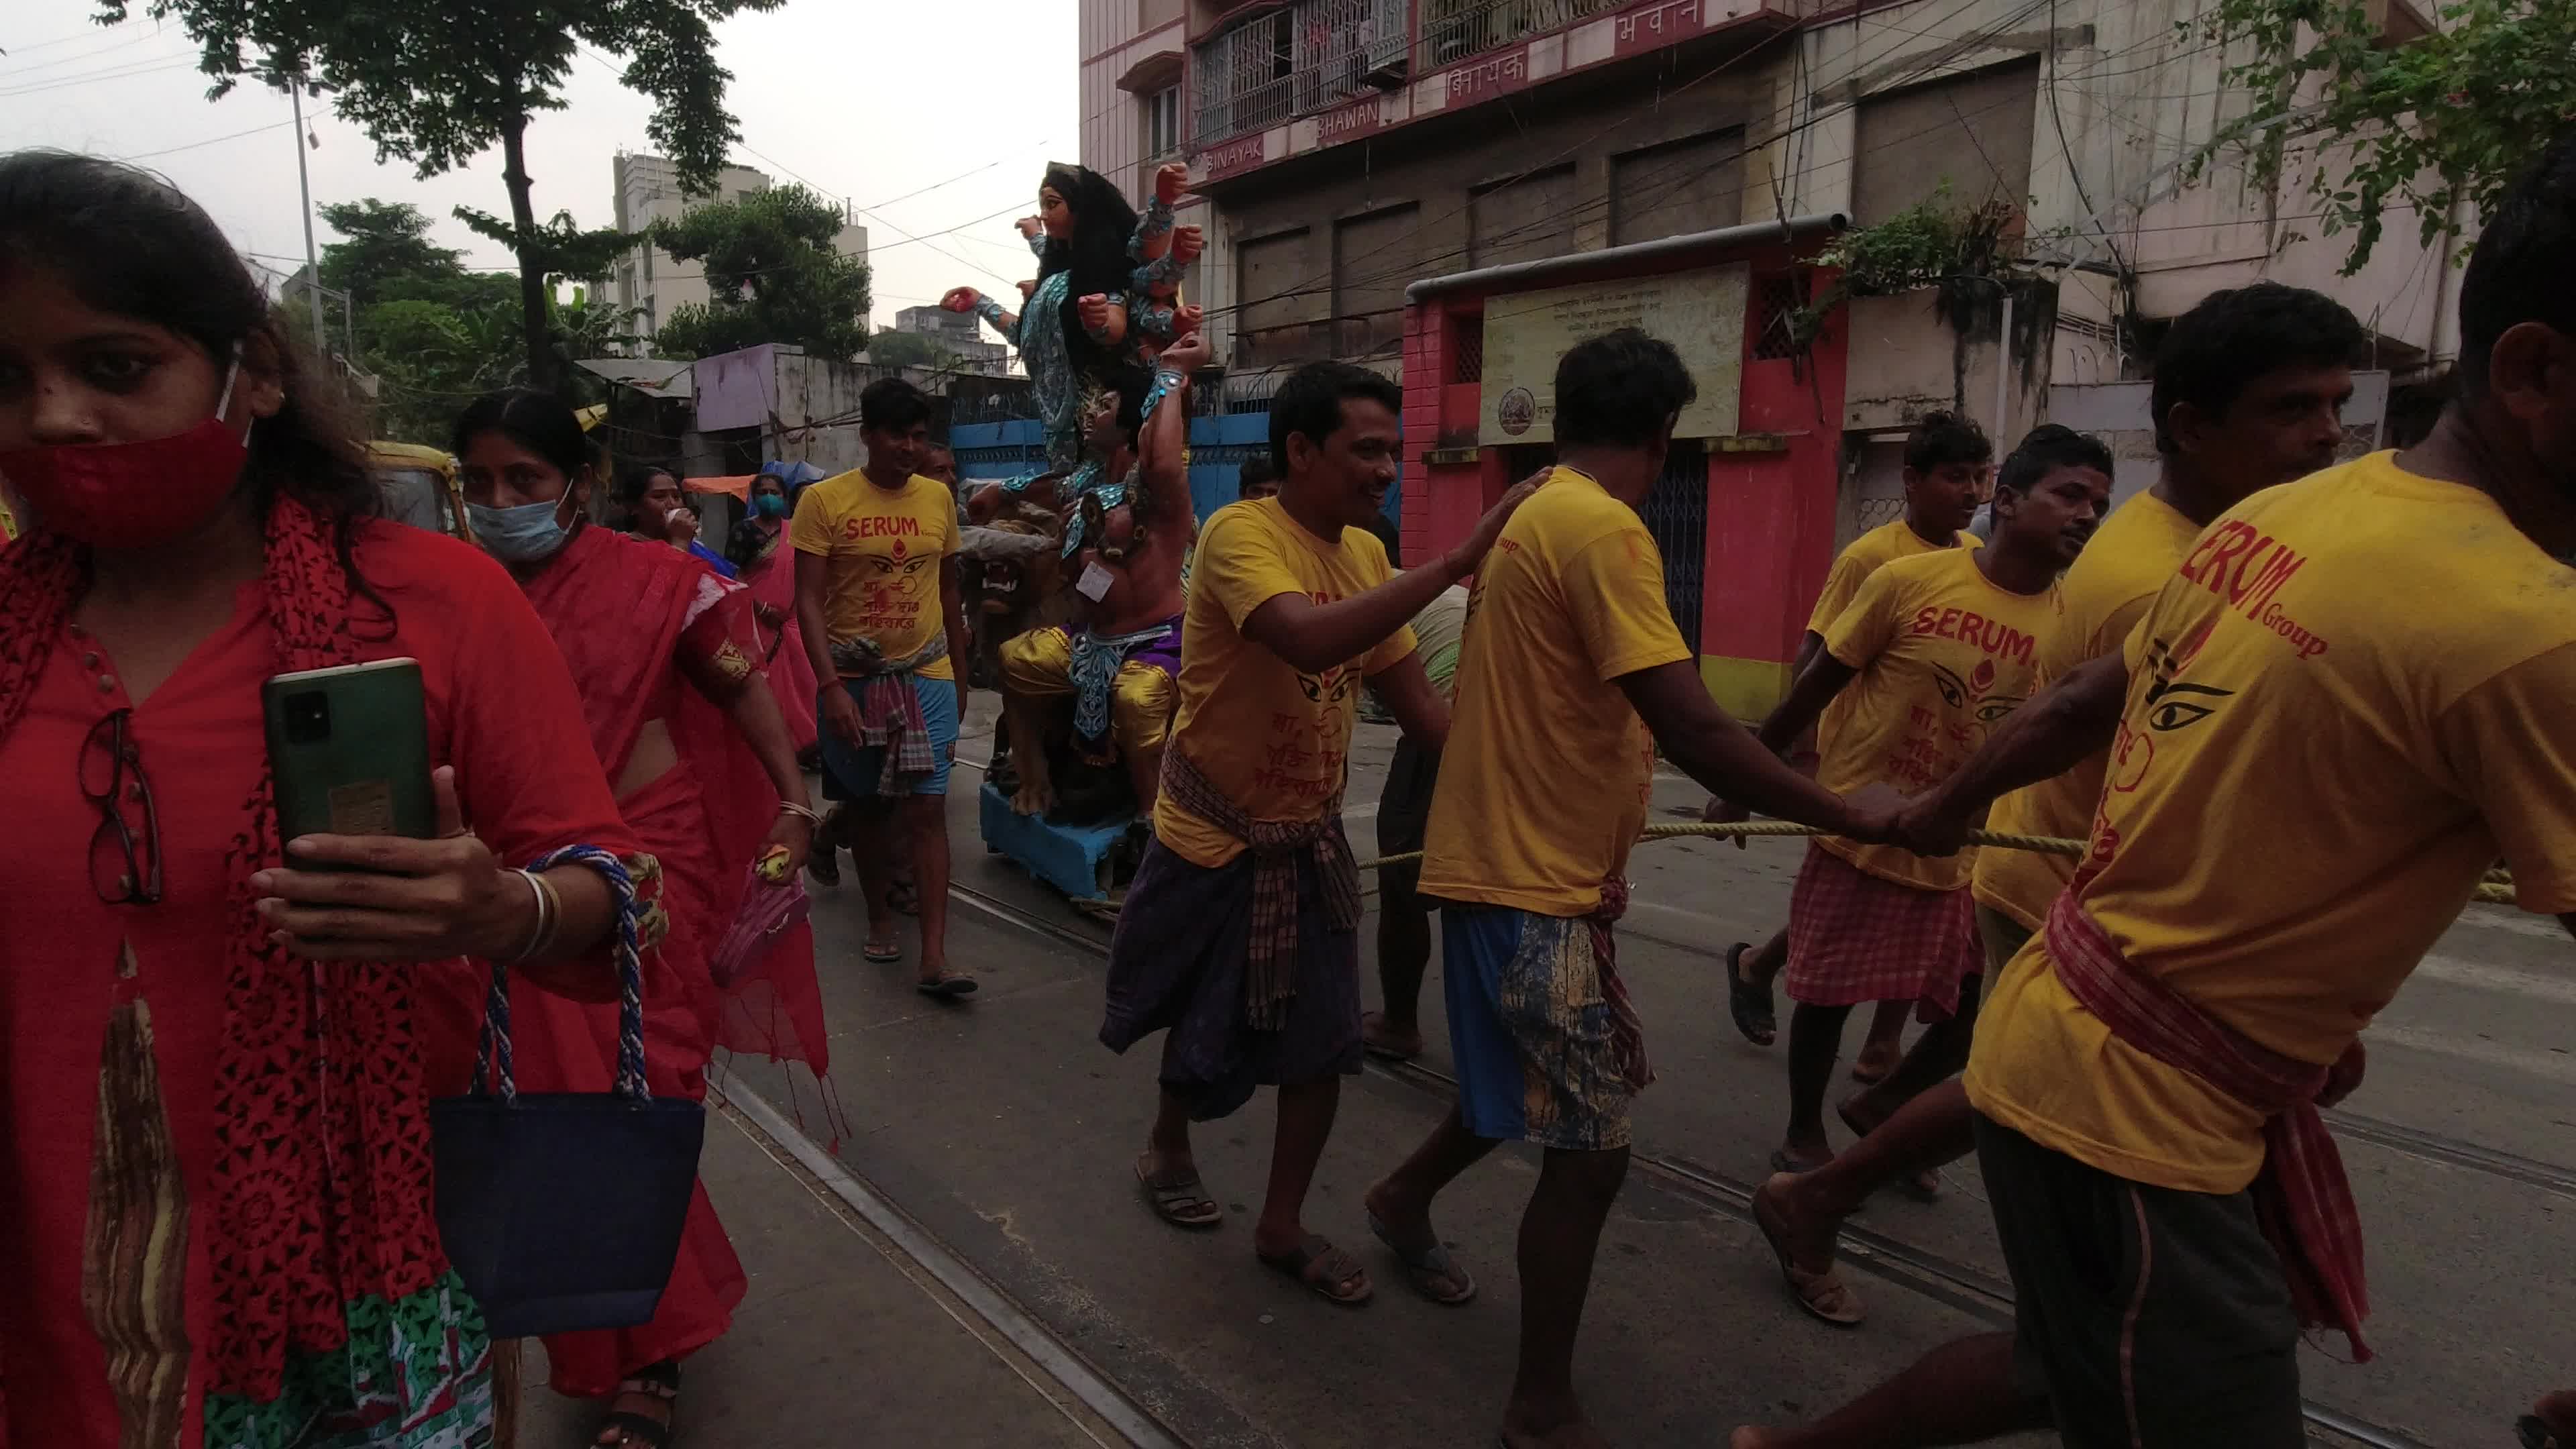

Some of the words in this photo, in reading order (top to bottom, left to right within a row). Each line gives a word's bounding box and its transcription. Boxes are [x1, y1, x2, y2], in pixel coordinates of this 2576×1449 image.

[1206, 138, 1262, 171] BINAYAK
[1316, 101, 1378, 140] BHAWAN
[847, 516, 920, 540] SERUM
[2180, 519, 2307, 621] ERUM
[2263, 603, 2328, 661] Group
[1912, 606, 2035, 666] SERUM
